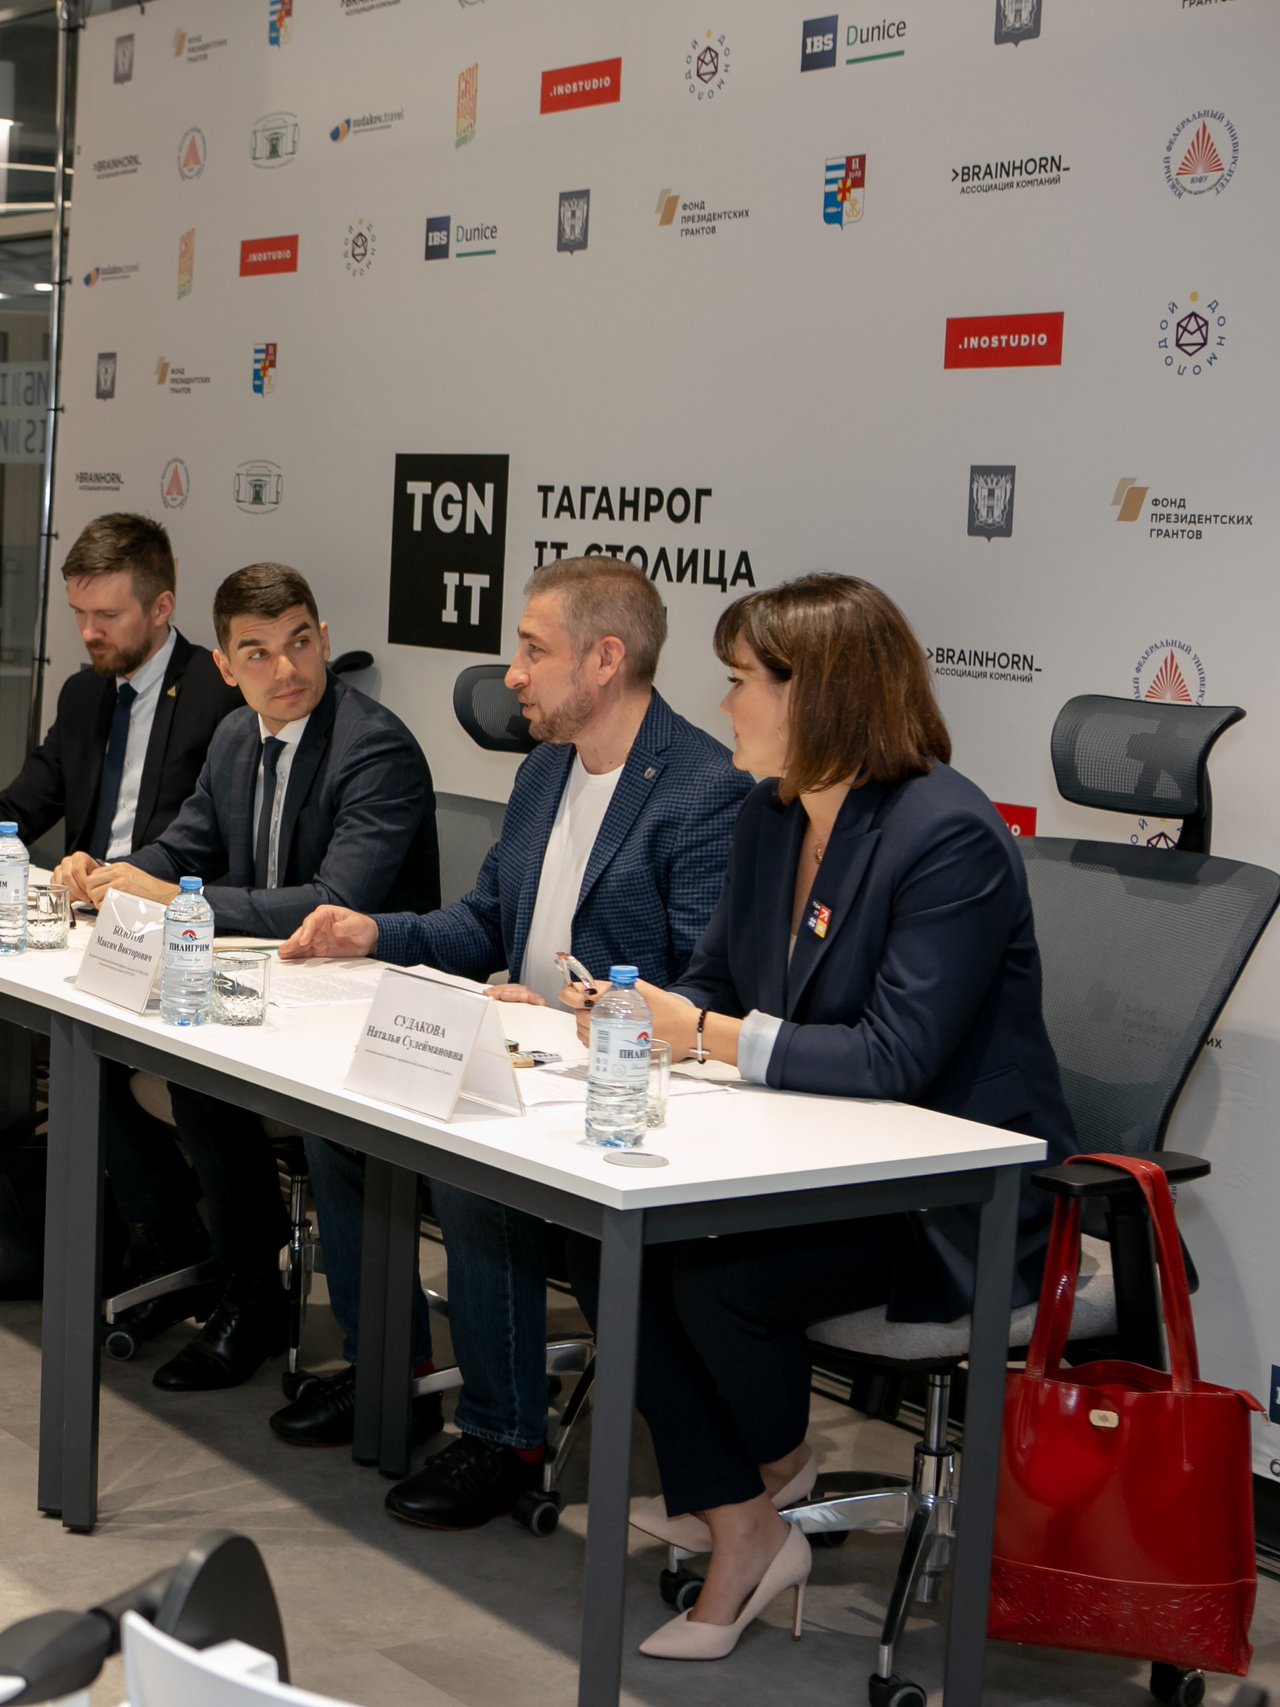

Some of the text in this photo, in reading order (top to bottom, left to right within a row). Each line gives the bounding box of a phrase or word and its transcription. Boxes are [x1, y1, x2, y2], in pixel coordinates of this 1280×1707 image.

[846, 19, 906, 46] Dunice
[805, 34, 833, 54] IBS
[549, 76, 611, 97] .INOSTUDIO
[960, 174, 1061, 195] АССОЦИАЦИЯ КОМПАНИЙ
[682, 201, 706, 211] ФОНД
[681, 209, 750, 225] ПРЕЗИДЕНТСКИХ
[427, 231, 448, 246] IBS
[456, 222, 498, 243] Dunice
[680, 226, 717, 238] ГРАНТОВ
[958, 333, 1048, 350] .INOSTUDIO
[407, 480, 495, 535] TGN
[537, 484, 713, 525] ТАГАНРОГ
[1151, 497, 1187, 510] ФОНД
[1150, 513, 1254, 526] ПРЕЗИДЕНТСКИХ
[1149, 529, 1203, 540] ГРАНТОВ
[441, 571, 490, 625] IT
[1135, 639, 1193, 674] ФЕДЕРАЛЬНЫЙ
[935, 667, 1033, 684] АССОЦИАЦИЯ КОМПАНИЙ
[96, 935, 153, 963] Максим Викторович
[169, 942, 210, 952] ПИЛИГРИМ
[394, 1014, 446, 1038] СУДАКОВА
[366, 1025, 464, 1062] Наталья Сулеймановна
